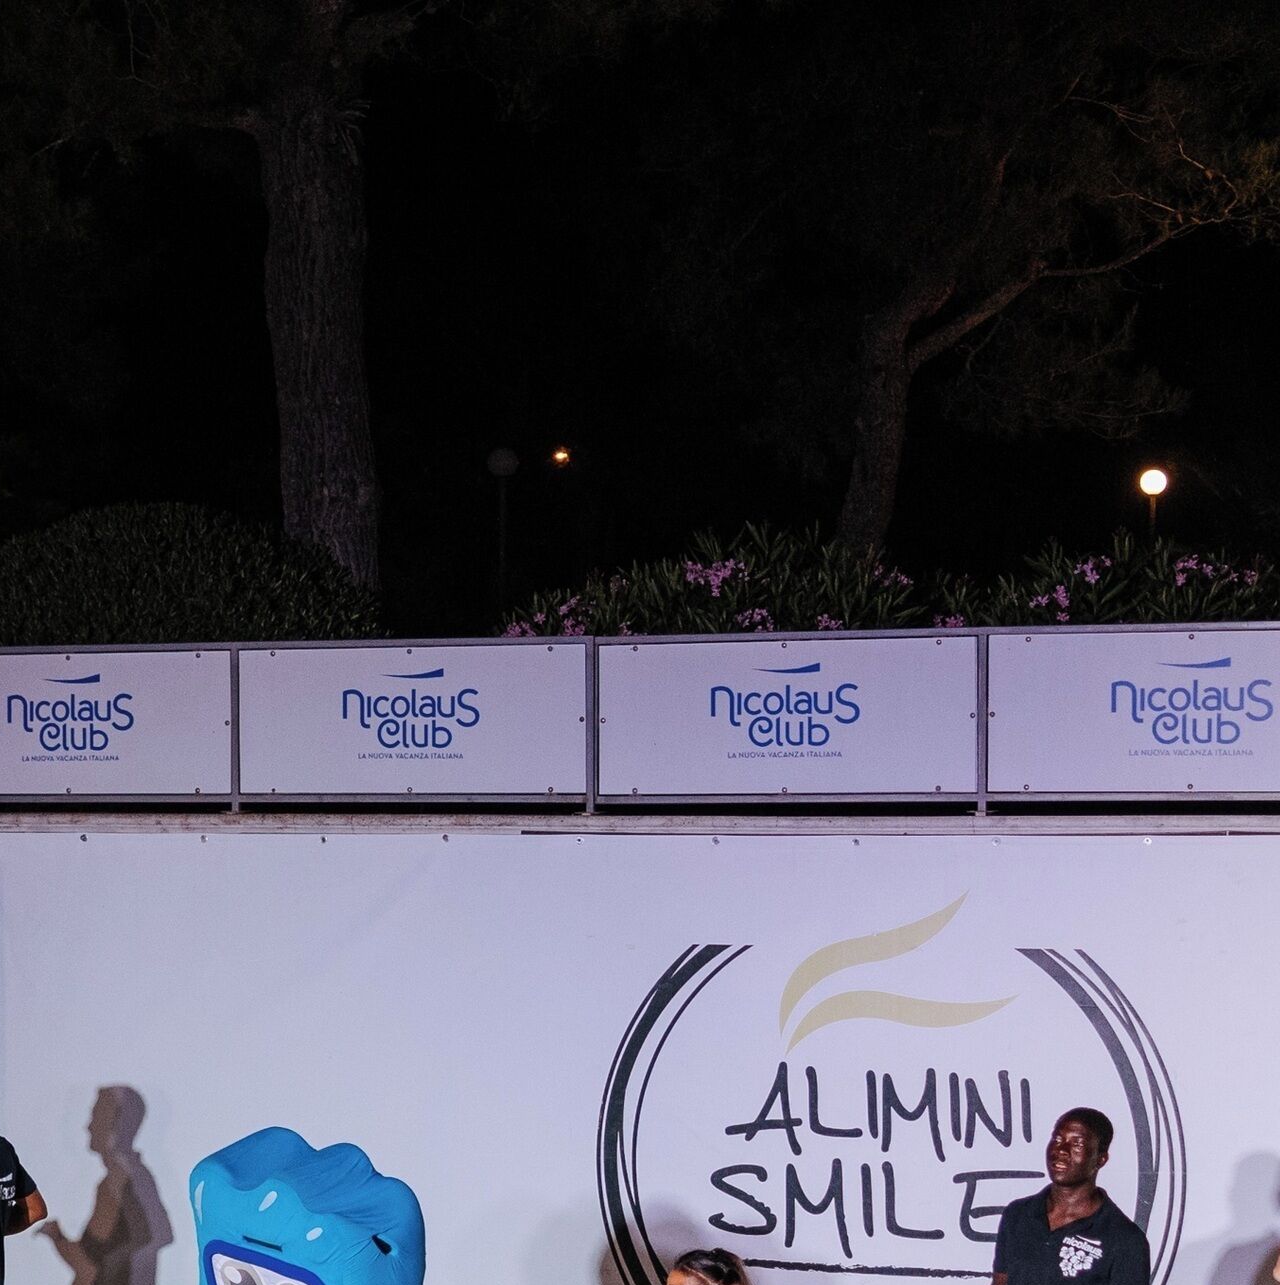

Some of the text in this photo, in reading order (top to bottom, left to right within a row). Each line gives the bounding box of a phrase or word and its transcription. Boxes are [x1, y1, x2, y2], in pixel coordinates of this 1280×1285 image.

[39, 723, 109, 751] Club
[377, 719, 452, 748] Club
[748, 716, 830, 747] Club
[1152, 712, 1240, 744] Club
[725, 1061, 1033, 1162] ALIMINI
[708, 1158, 1045, 1260] SMILE
